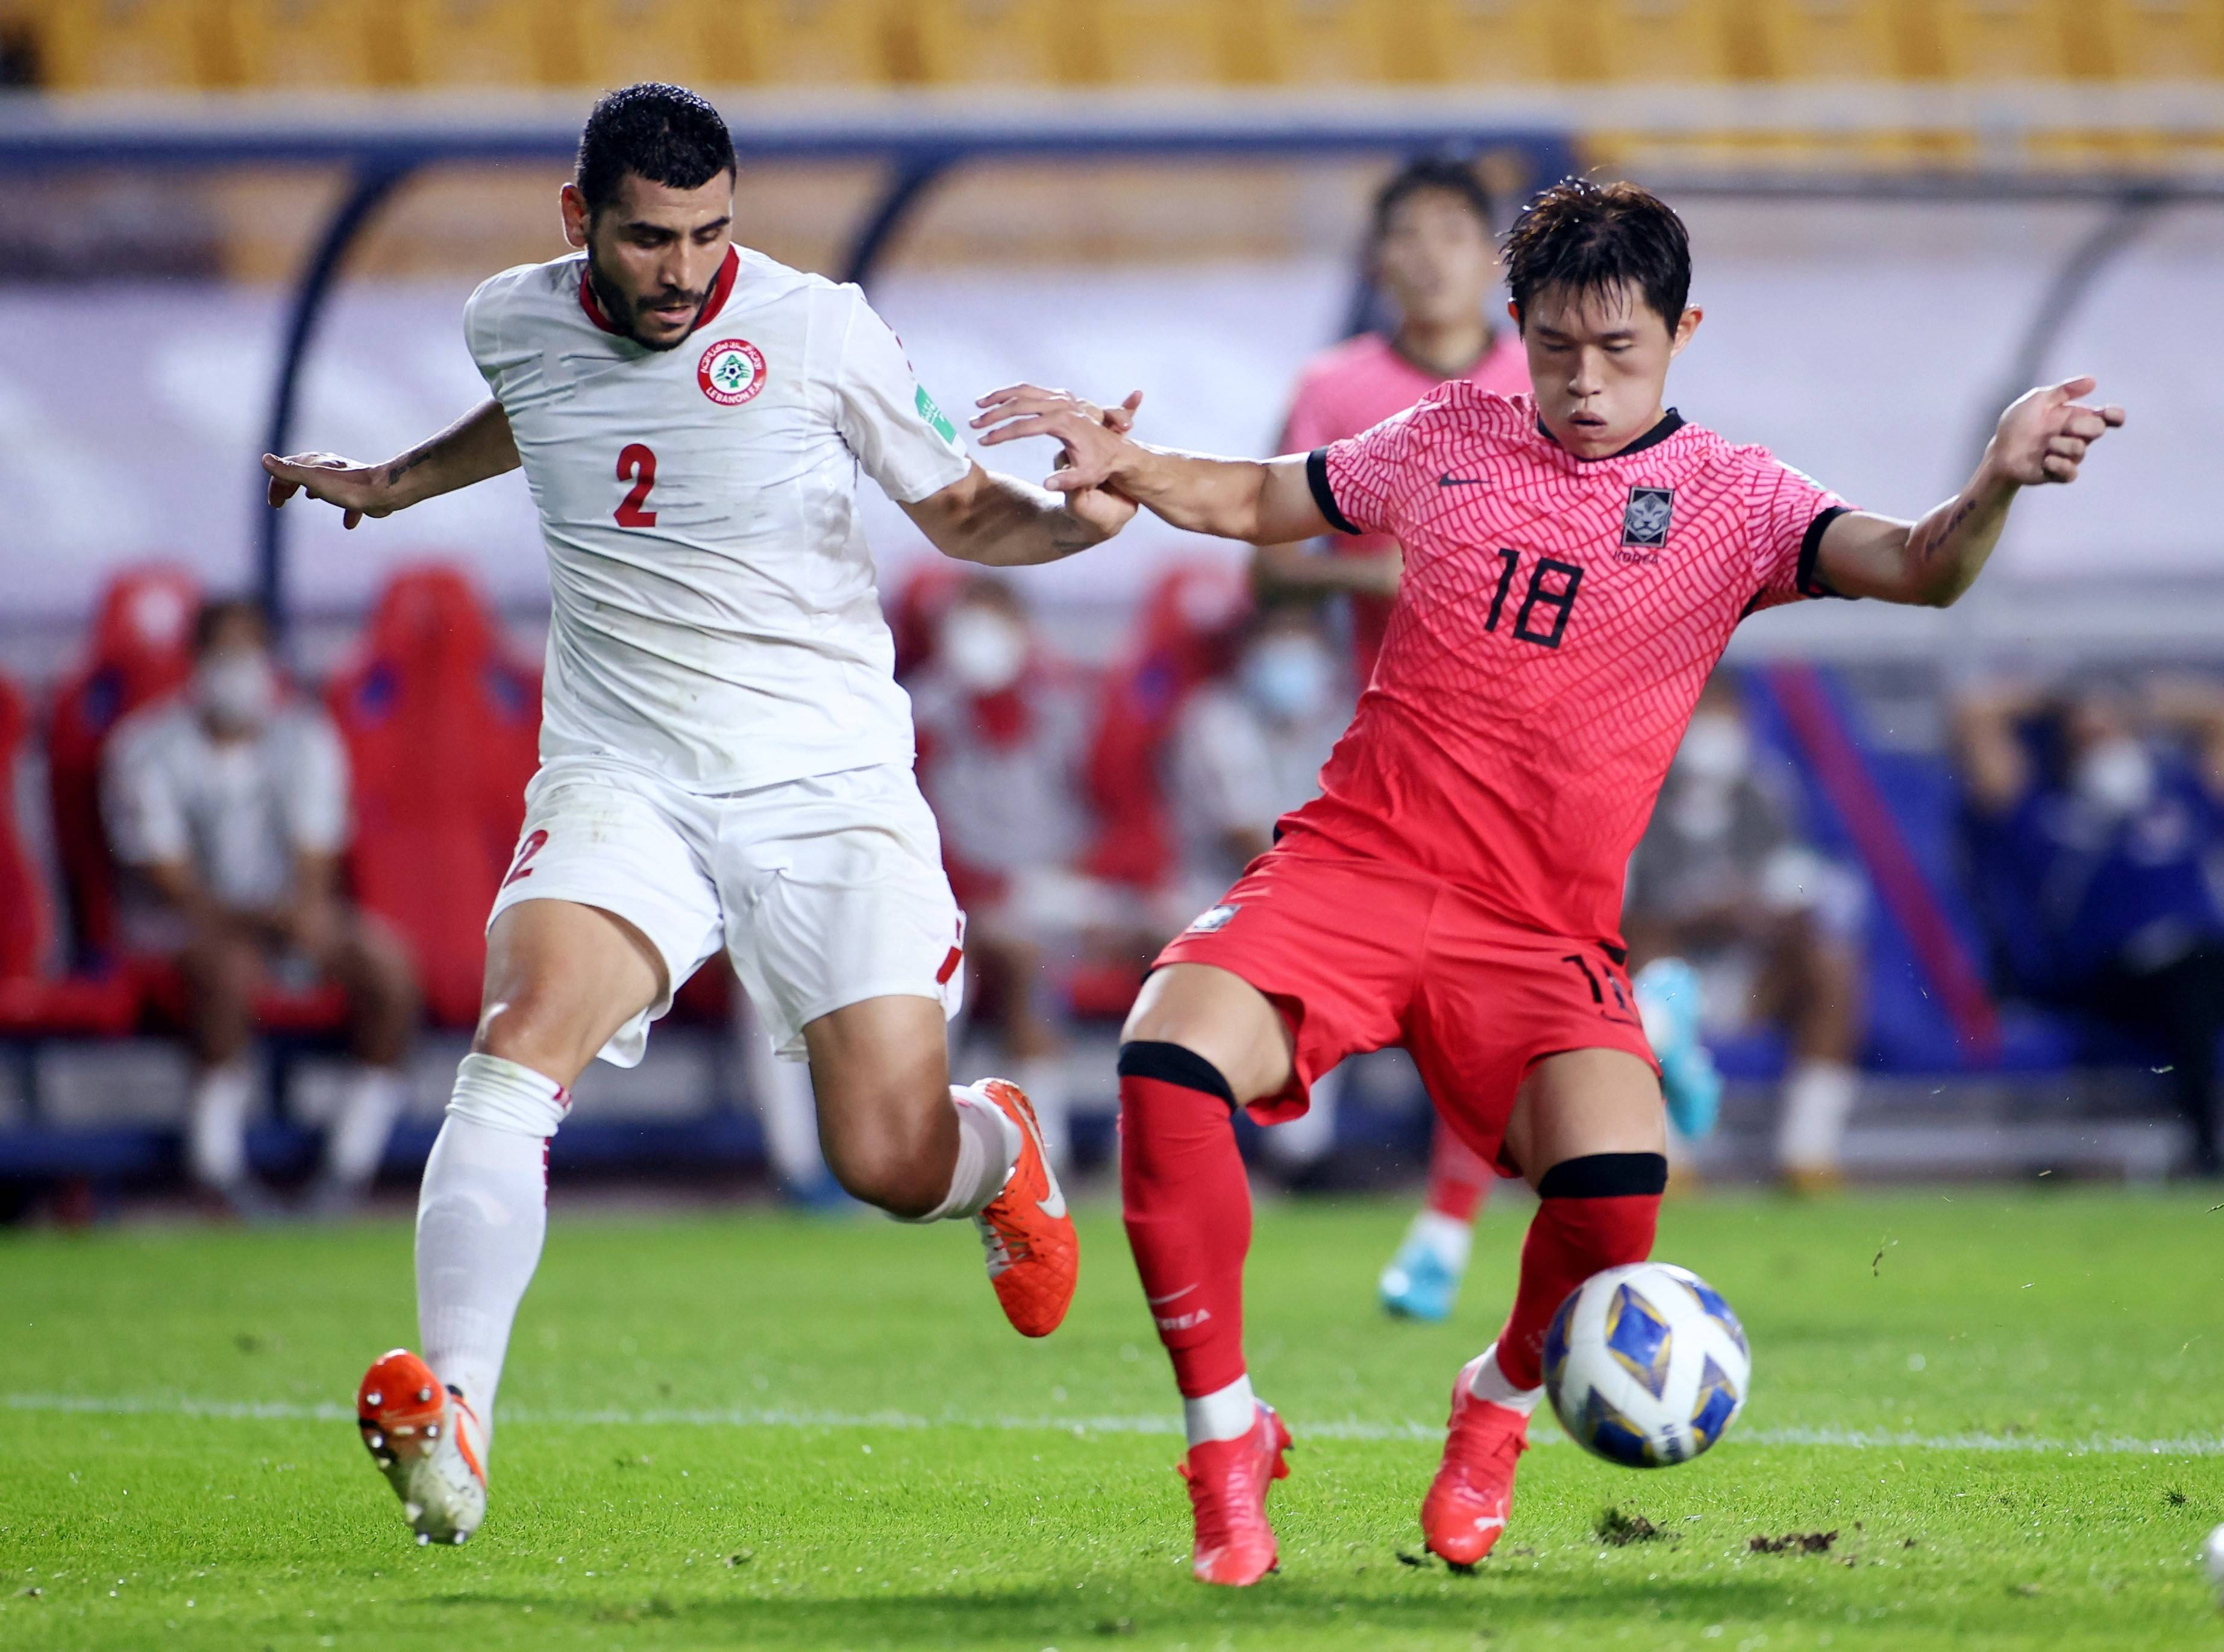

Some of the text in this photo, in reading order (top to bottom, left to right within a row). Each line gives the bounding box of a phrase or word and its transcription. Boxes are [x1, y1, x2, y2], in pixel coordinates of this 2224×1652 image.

[706, 387, 750, 404] LEBANON
[613, 443, 657, 527] 2
[1484, 548, 1585, 649] 18
[504, 830, 549, 889] 2
